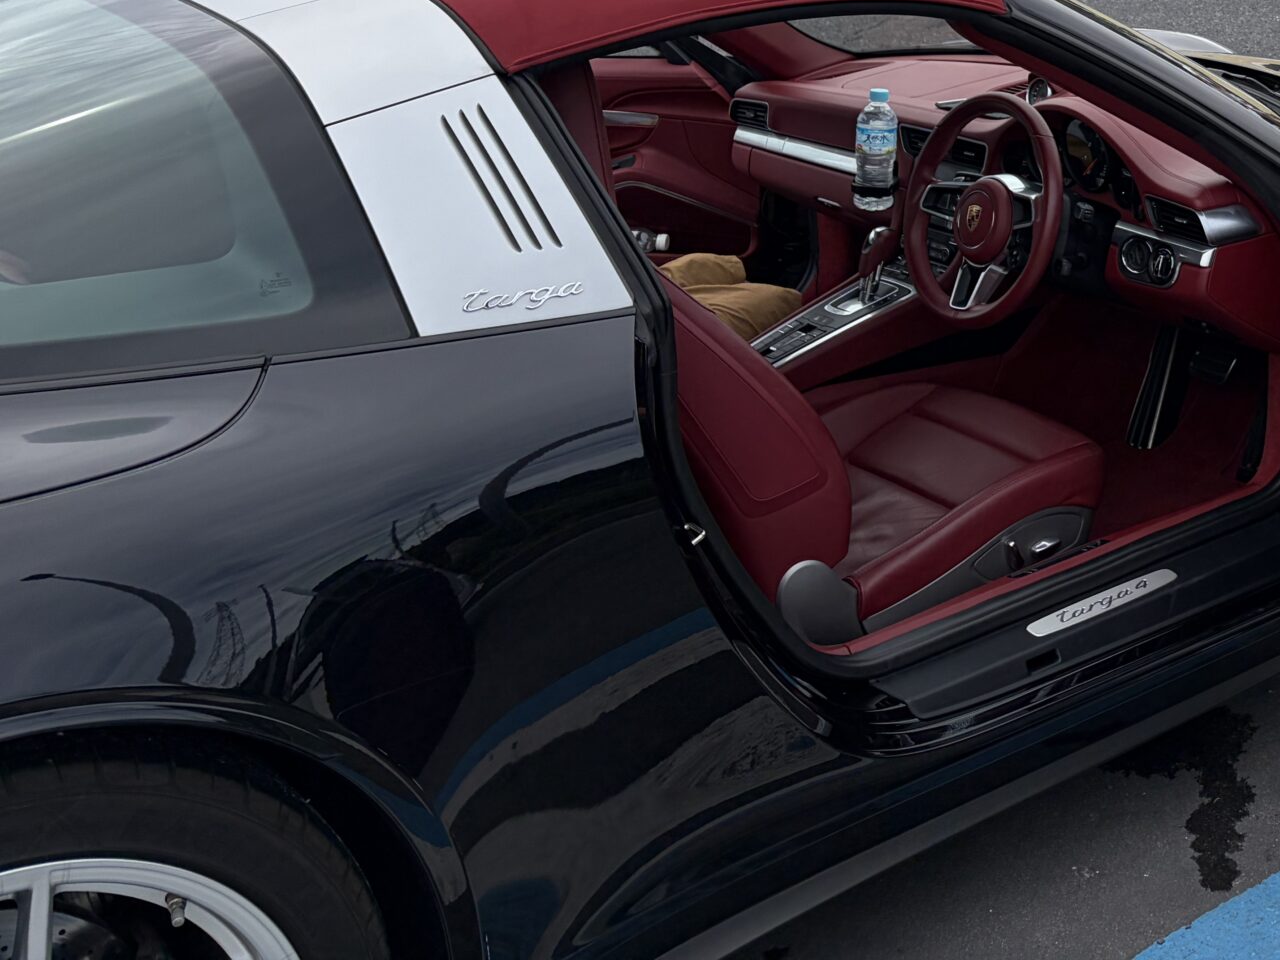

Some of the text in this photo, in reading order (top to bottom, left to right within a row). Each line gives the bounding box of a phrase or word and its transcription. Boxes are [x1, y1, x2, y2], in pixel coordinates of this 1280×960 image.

[463, 281, 583, 312] targa
[1056, 578, 1149, 623] targa 4
